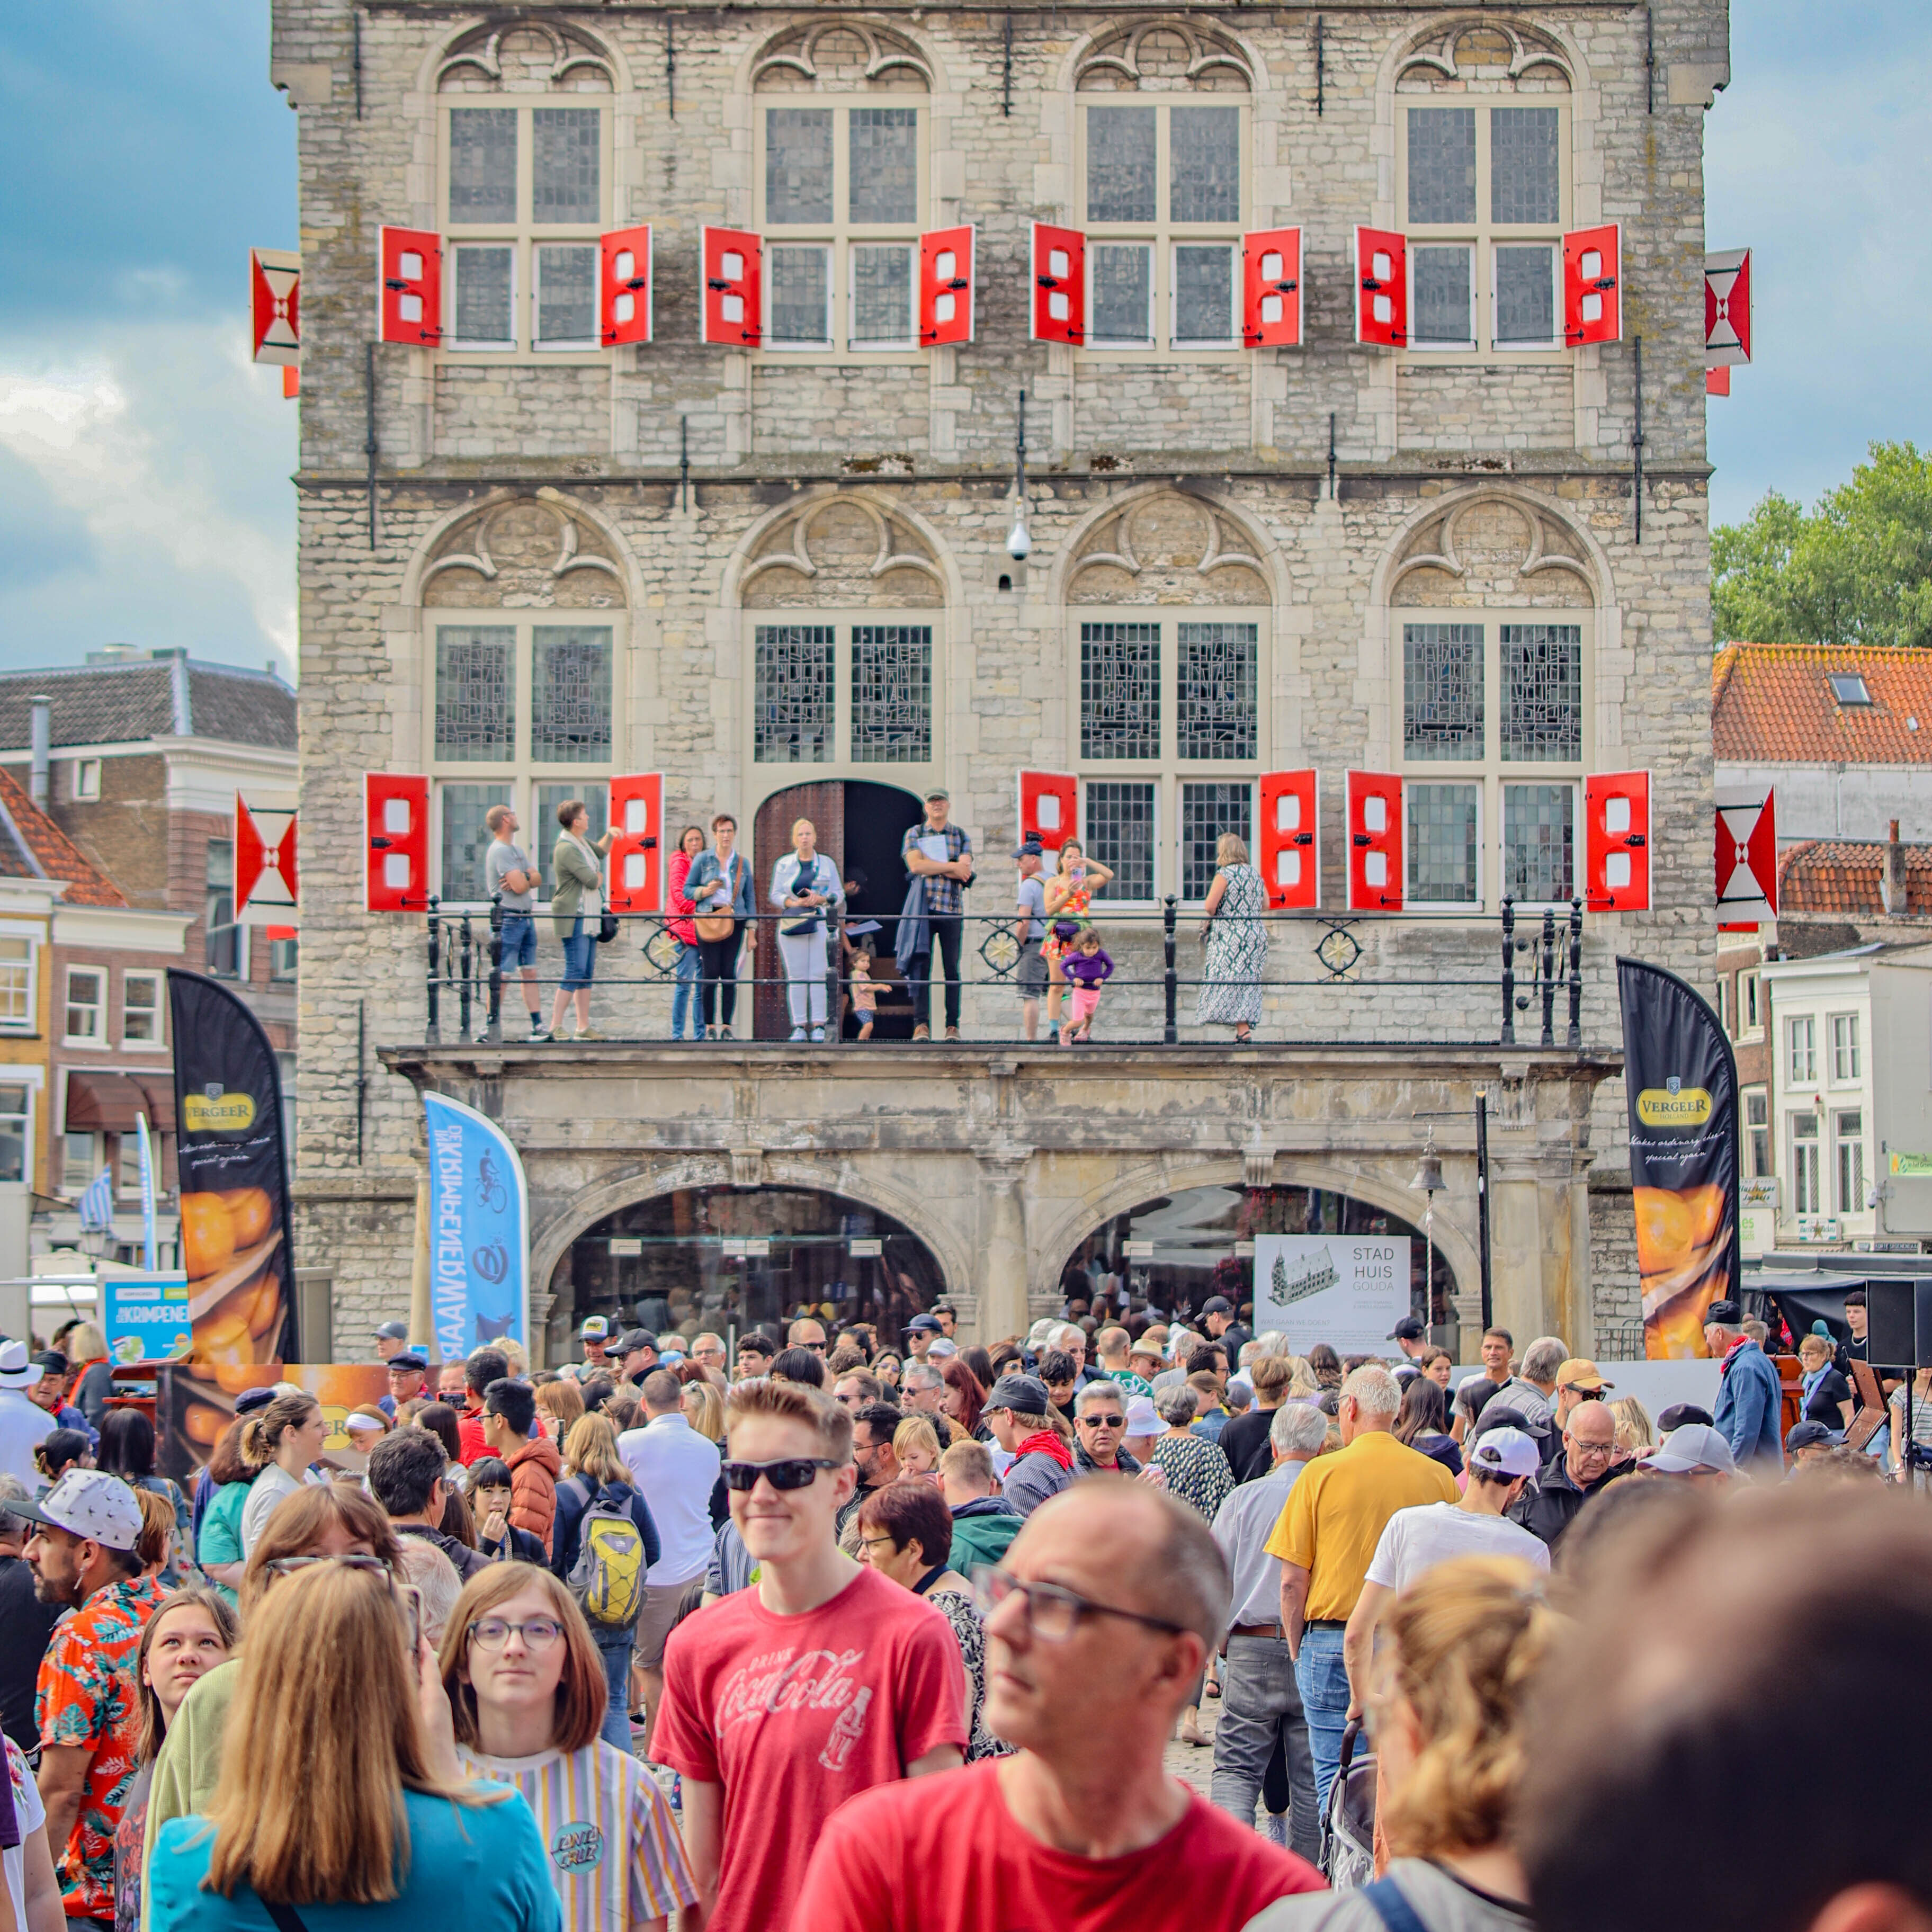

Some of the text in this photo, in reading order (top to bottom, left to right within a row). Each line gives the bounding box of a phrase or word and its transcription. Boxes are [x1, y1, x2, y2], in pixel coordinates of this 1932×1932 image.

[1642, 1098, 1707, 1113] VERGEER
[1630, 1134, 1655, 1146] Makes
[1658, 1137, 1701, 1148] ordinary
[1645, 1148, 1707, 1166] special again
[1353, 1247, 1394, 1260] STAD
[1355, 1265, 1392, 1278] HUIS
[1353, 1281, 1394, 1291] GOUDA
[127, 1305, 191, 1323] KRIMPENE
[748, 1647, 795, 1672] DRINK
